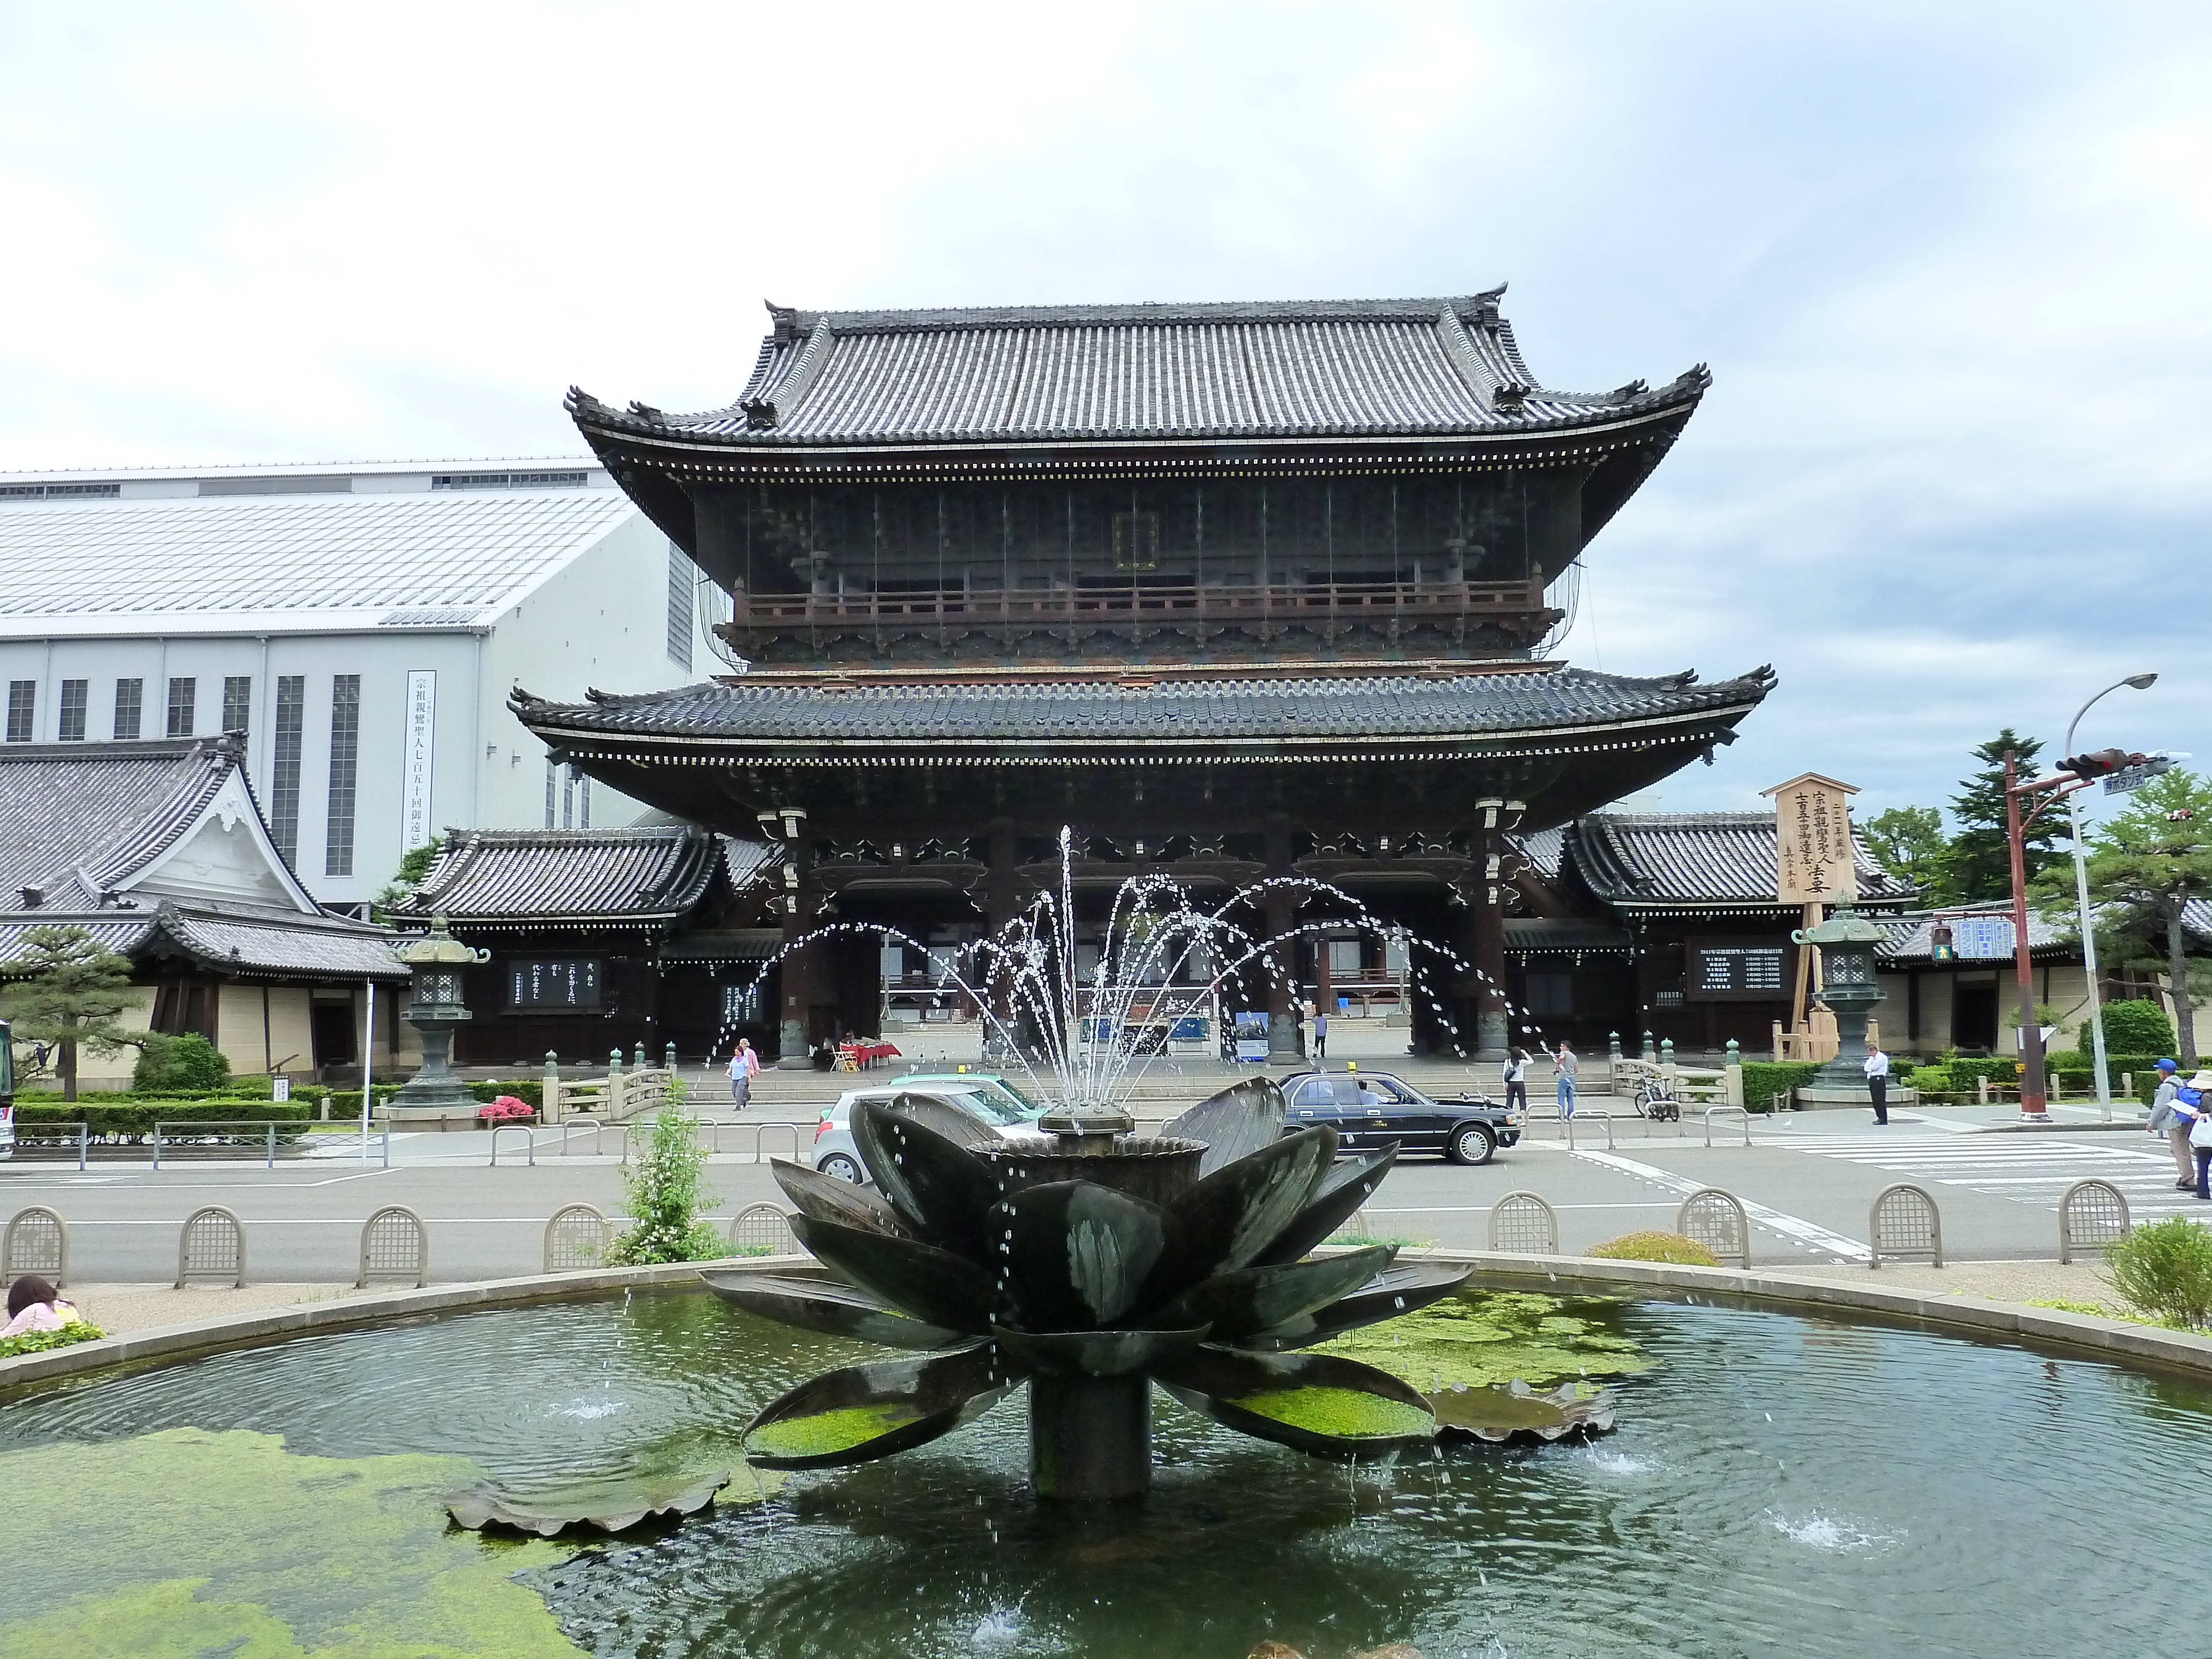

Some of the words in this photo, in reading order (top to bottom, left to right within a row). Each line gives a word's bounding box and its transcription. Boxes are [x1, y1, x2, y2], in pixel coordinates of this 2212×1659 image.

[410, 678, 426, 844] 宗祖親鸞聖人七百五十回御遠忌
[2105, 774, 2143, 792] 押ボタン式
[1795, 792, 1813, 865] 七百五十回御遠忌
[1813, 791, 1834, 864] 宗祖親鸞聖人
[1783, 846, 1797, 889] 真宗本廟
[1804, 864, 1831, 893] 法要
[1962, 923, 1971, 956] 押ボタン式
